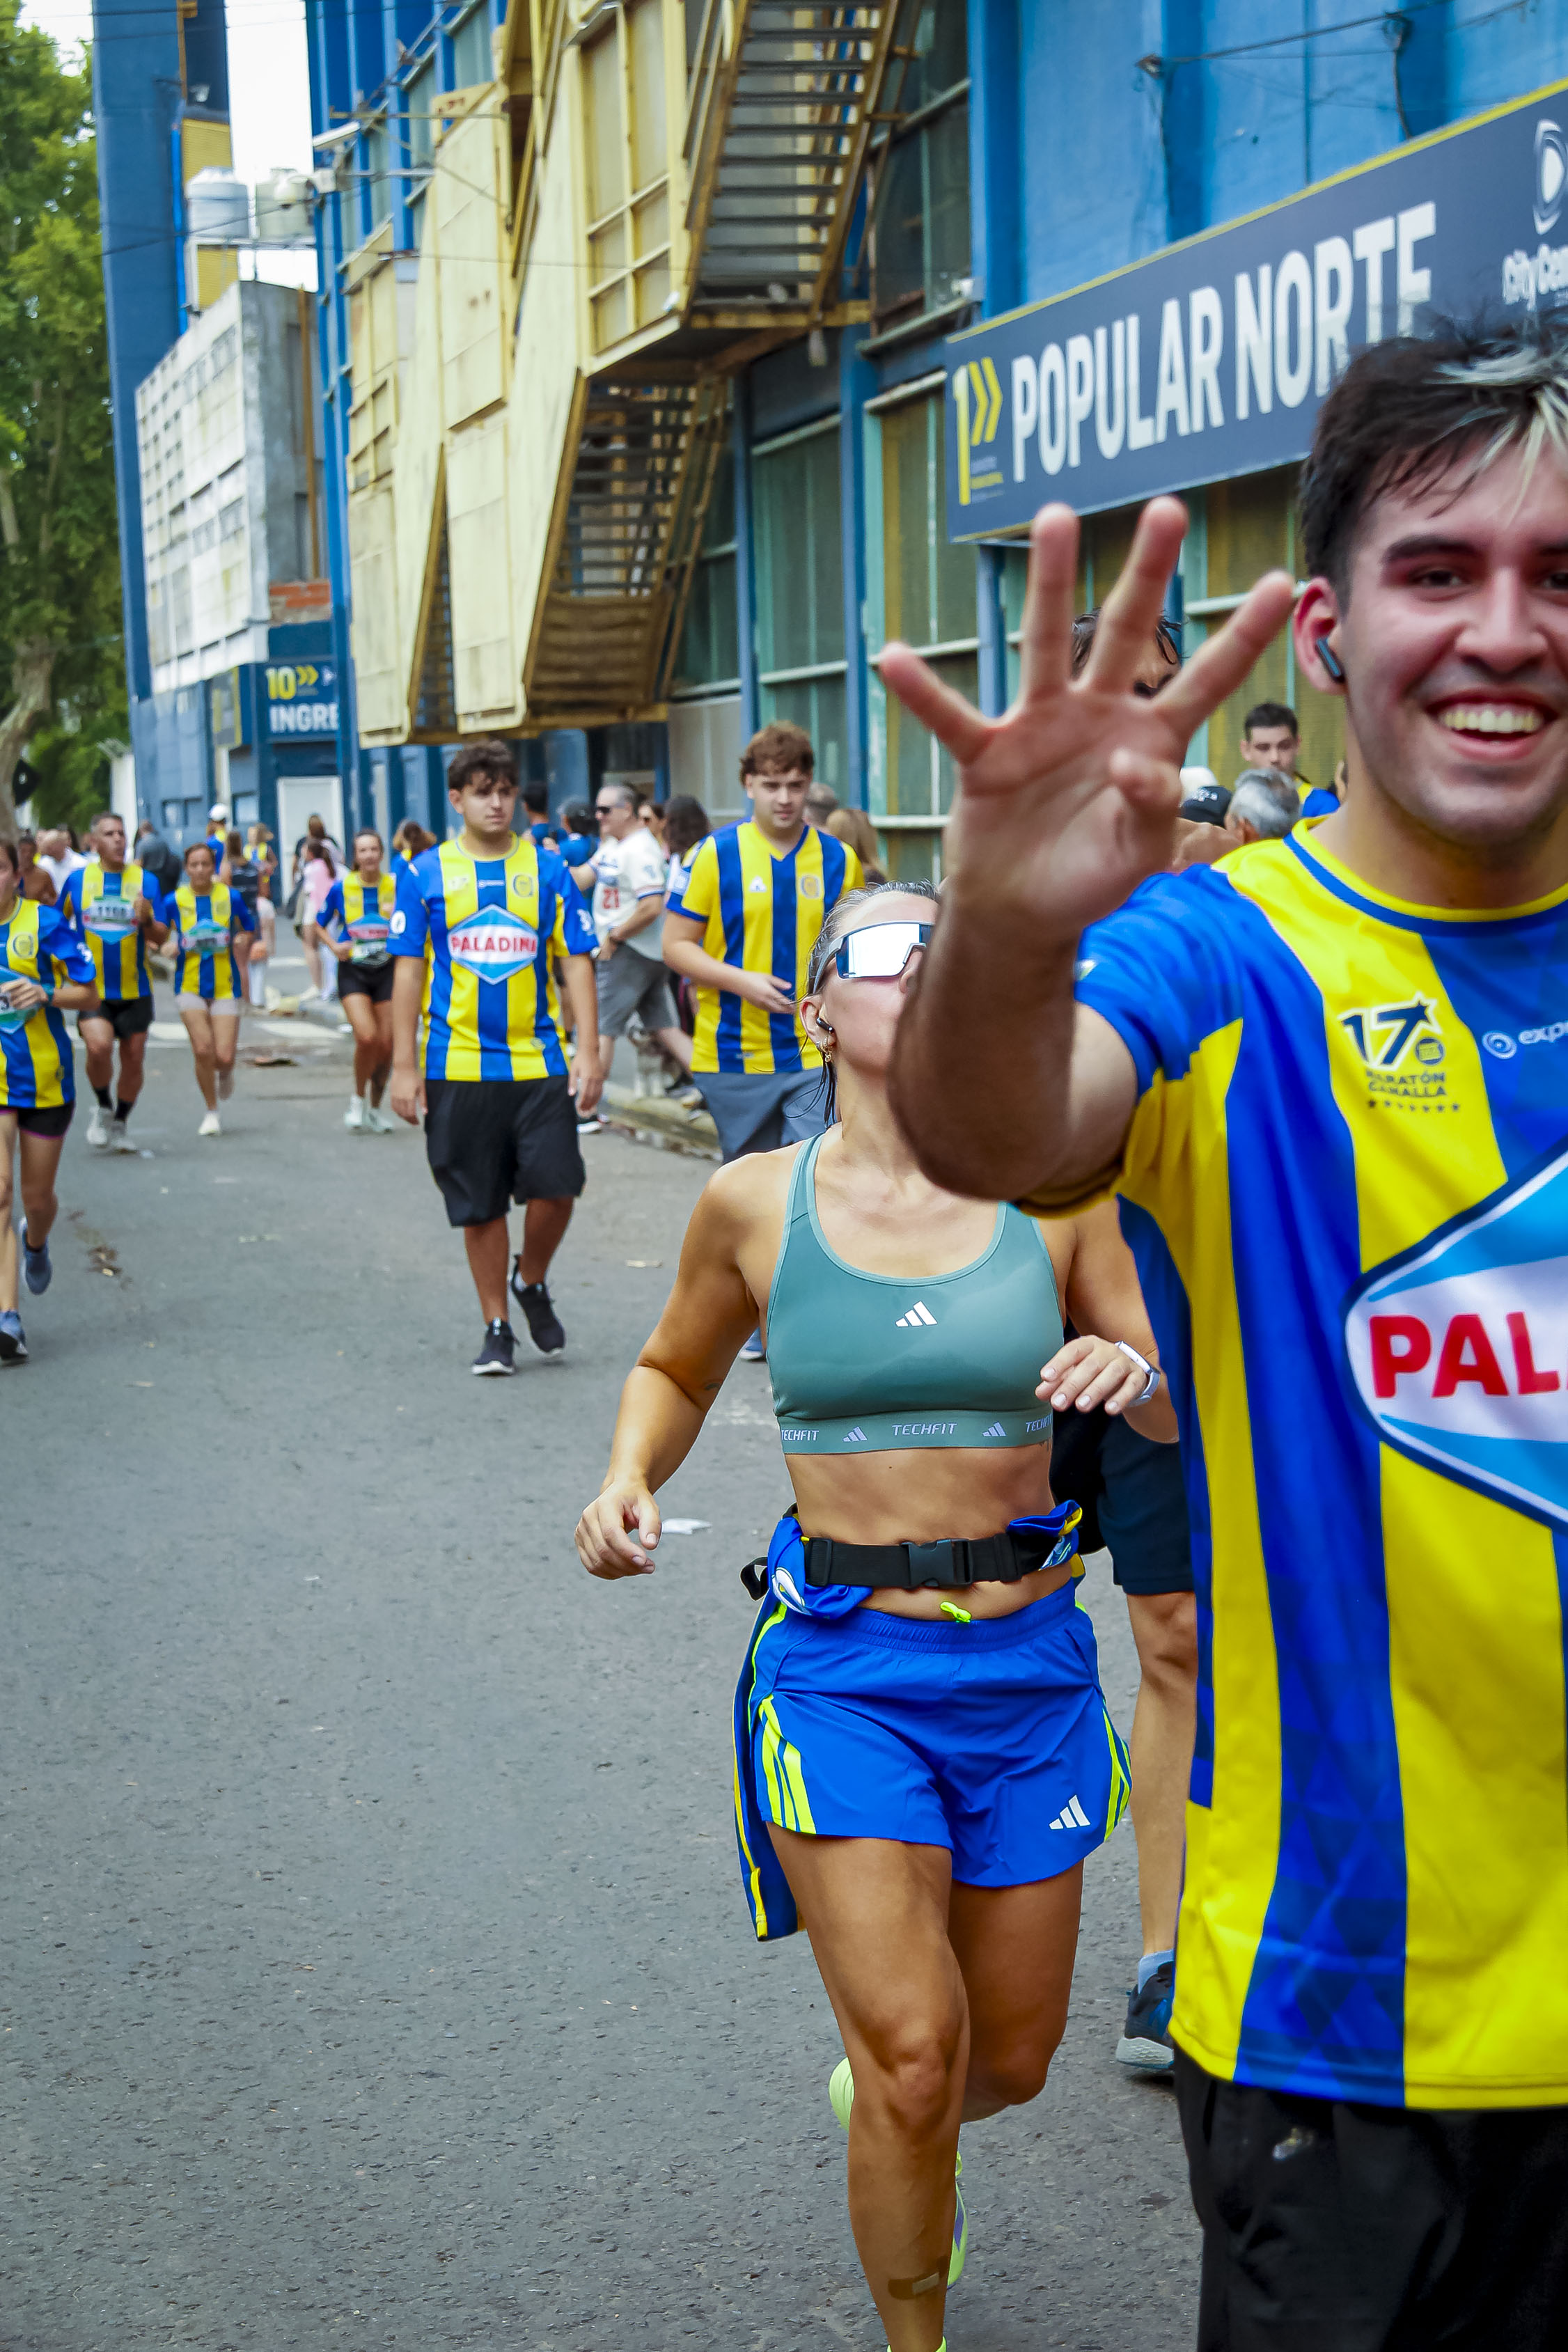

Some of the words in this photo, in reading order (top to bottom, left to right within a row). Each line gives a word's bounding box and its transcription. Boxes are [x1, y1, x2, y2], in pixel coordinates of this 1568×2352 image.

[1011, 286, 1223, 483] POPULAR
[1234, 201, 1436, 421] NORTE
[266, 666, 297, 700] 10
[603, 888, 620, 909] 21
[1338, 992, 1442, 1072] 17
[1369, 1312, 1568, 1399] PAL
[781, 1429, 819, 1441] TECHFIT
[892, 1422, 957, 1436] TECHFIT
